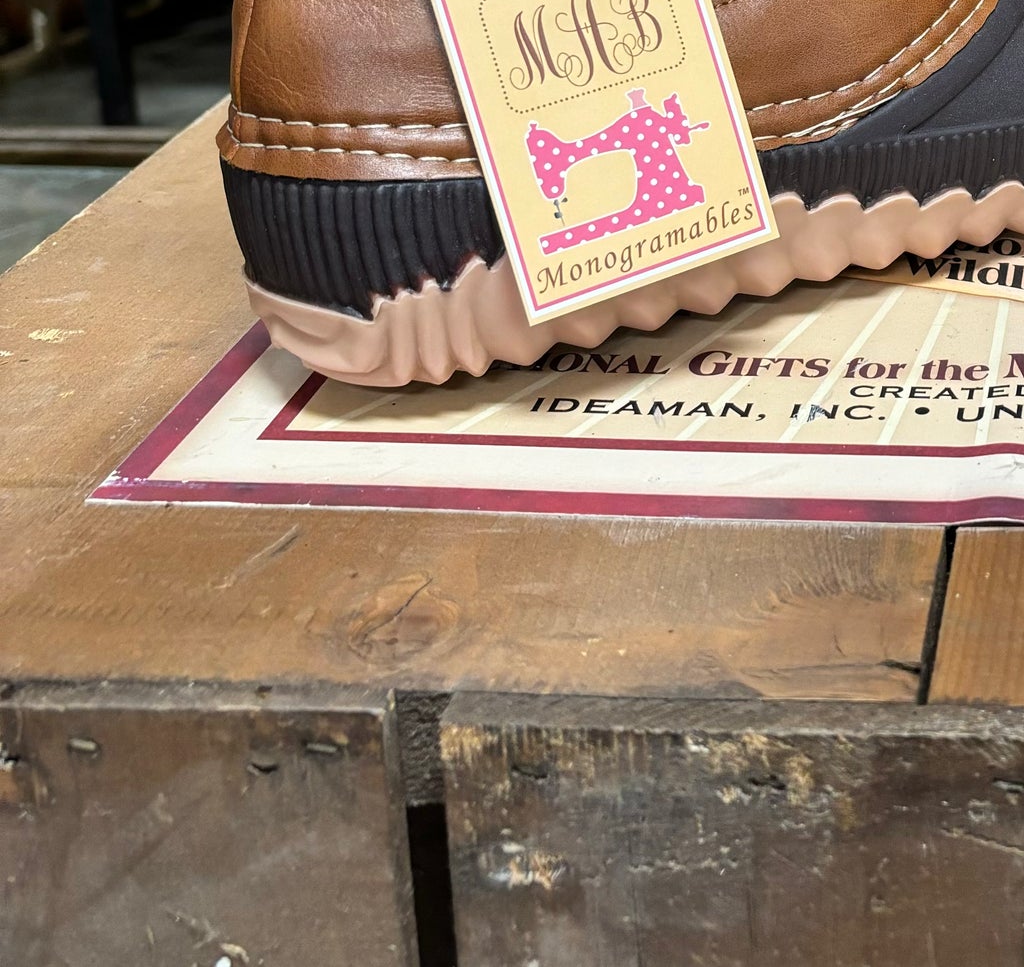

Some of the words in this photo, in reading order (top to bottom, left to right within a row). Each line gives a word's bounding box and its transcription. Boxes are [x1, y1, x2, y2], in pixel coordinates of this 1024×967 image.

[537, 200, 754, 295] Monogramables
[688, 350, 831, 379] GIFTS
[842, 357, 906, 381] for
[921, 359, 990, 382] the
[530, 397, 767, 422] IDEAMAN,
